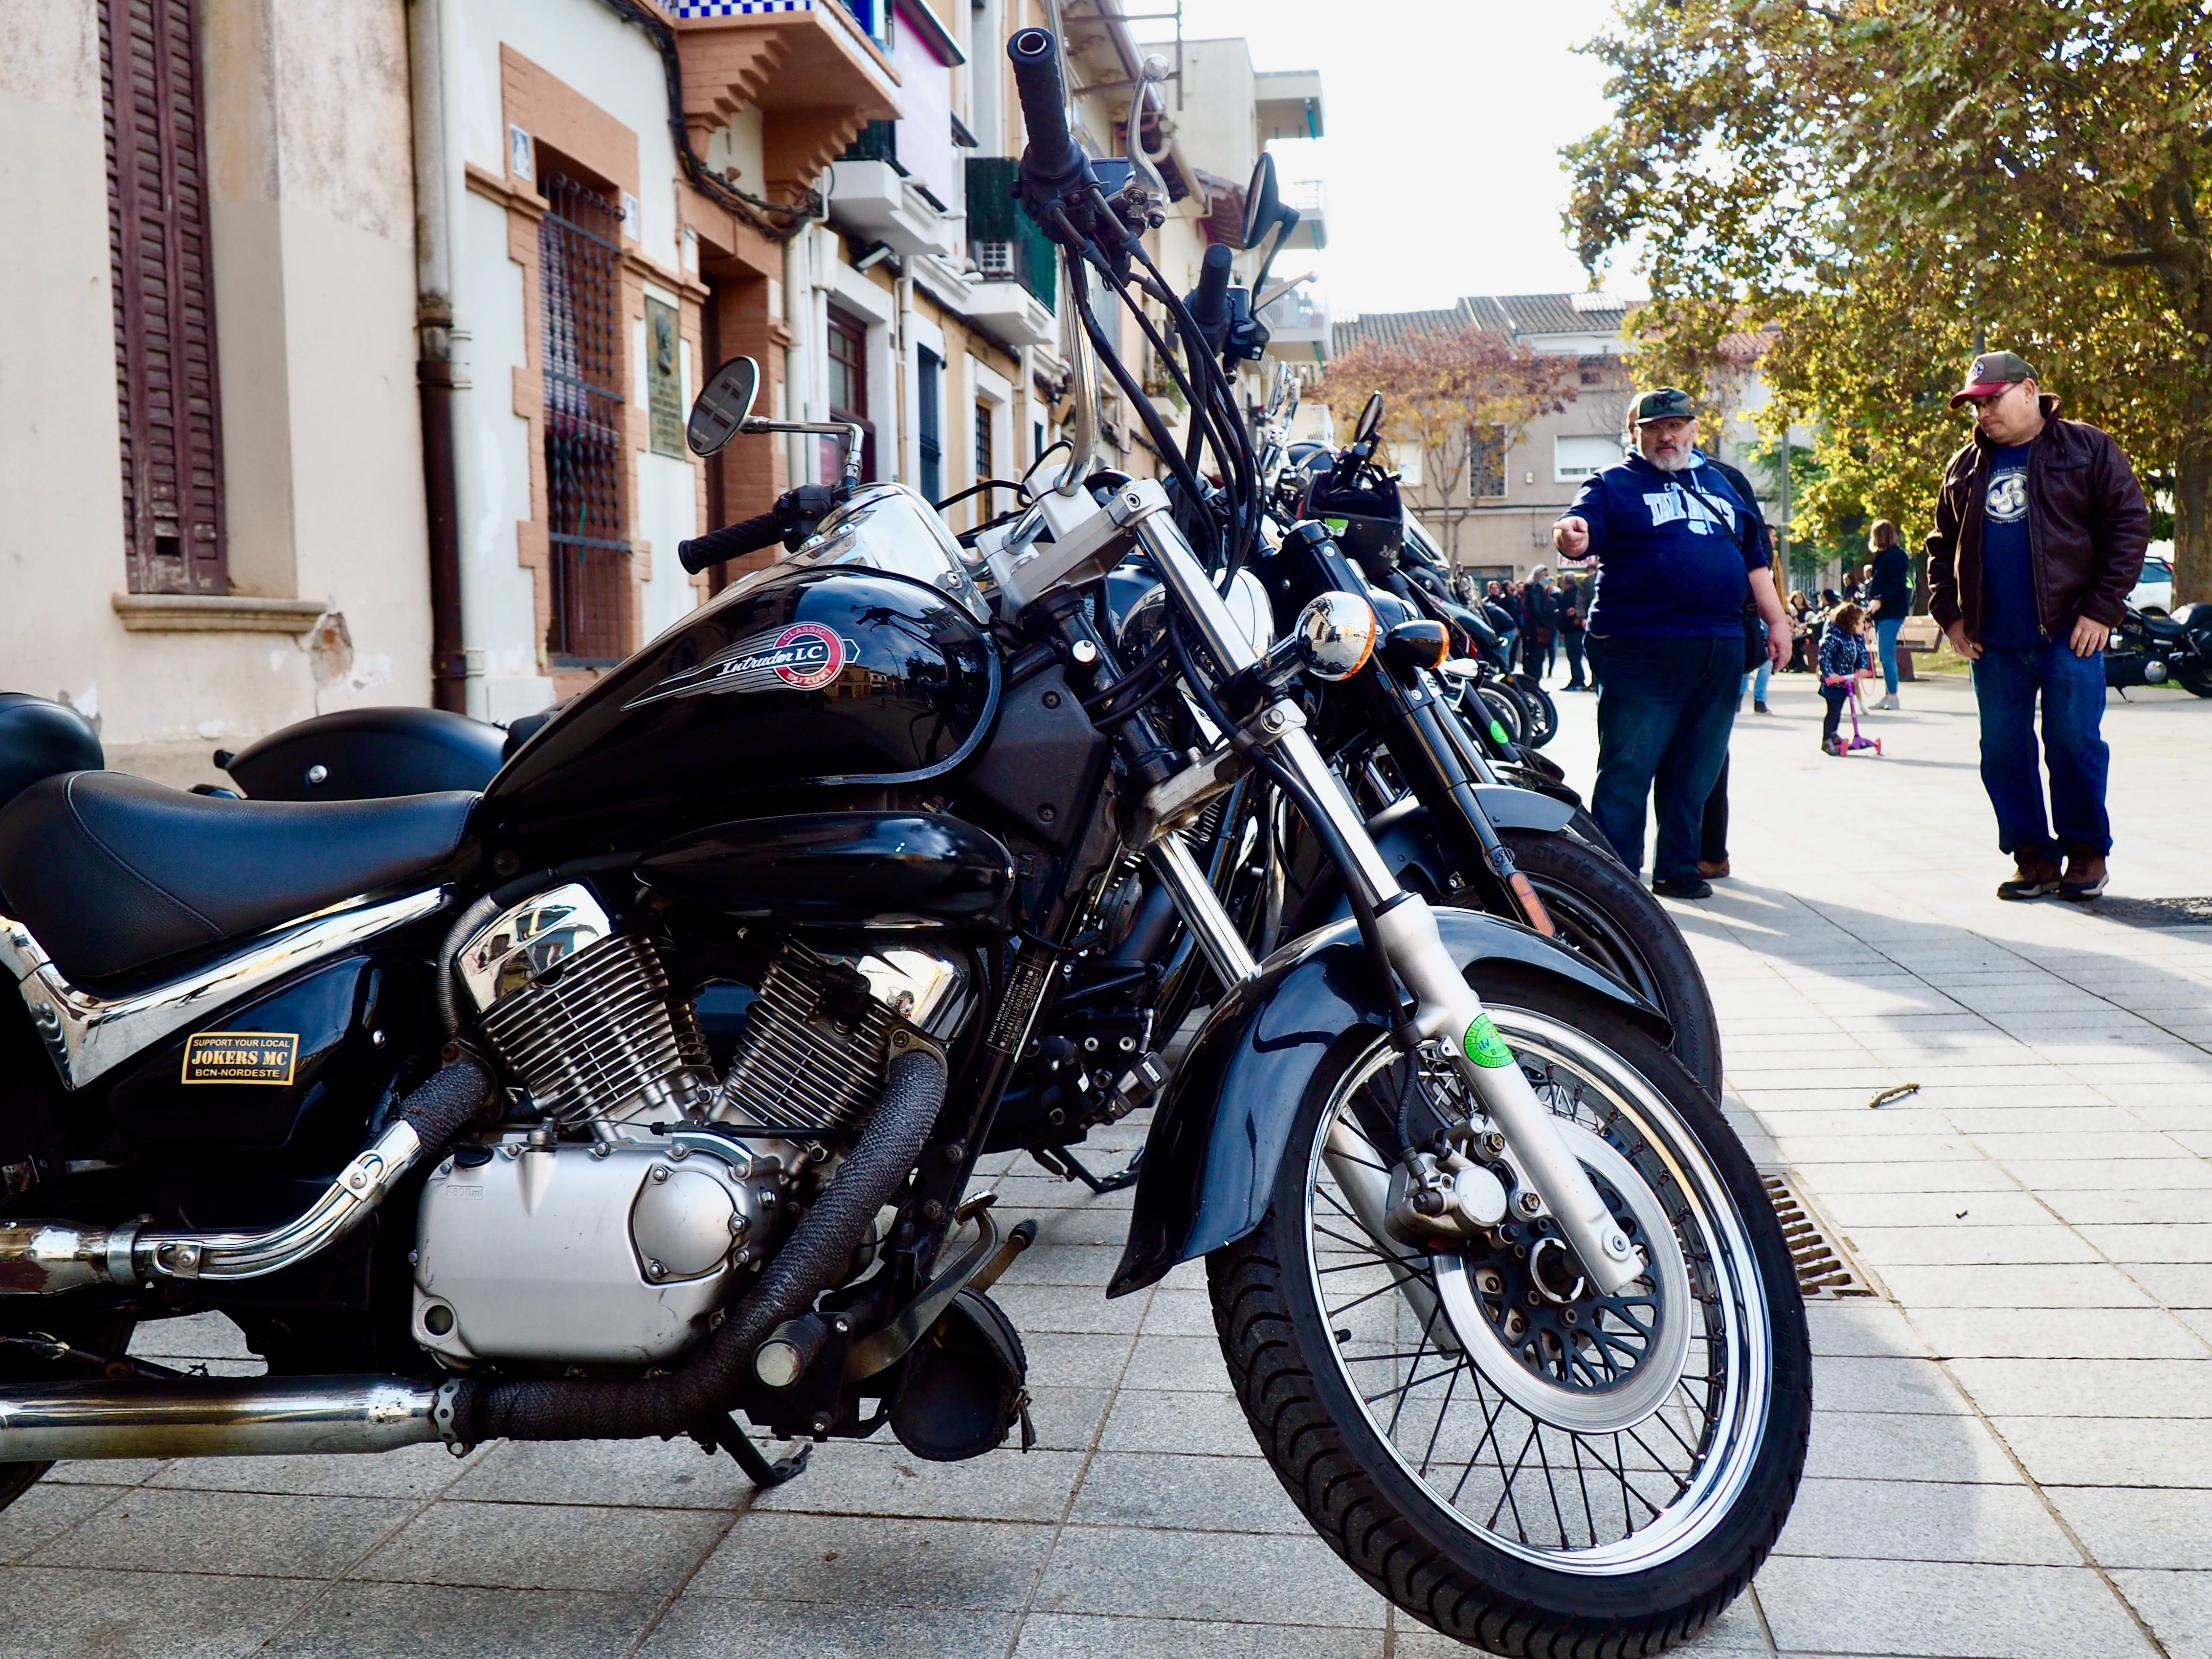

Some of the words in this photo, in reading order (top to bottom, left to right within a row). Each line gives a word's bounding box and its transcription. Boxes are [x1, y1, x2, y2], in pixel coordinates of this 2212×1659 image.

[782, 626, 827, 641] CLASSIC
[716, 650, 794, 676] Intruder
[795, 646, 824, 661] LC
[787, 668, 832, 684] SUZUKI
[995, 1002, 1006, 1021] MOTOR
[191, 1051, 258, 1065] JOKERS
[262, 1051, 288, 1065] MC
[195, 1069, 280, 1077] BCN-NORDESTE
